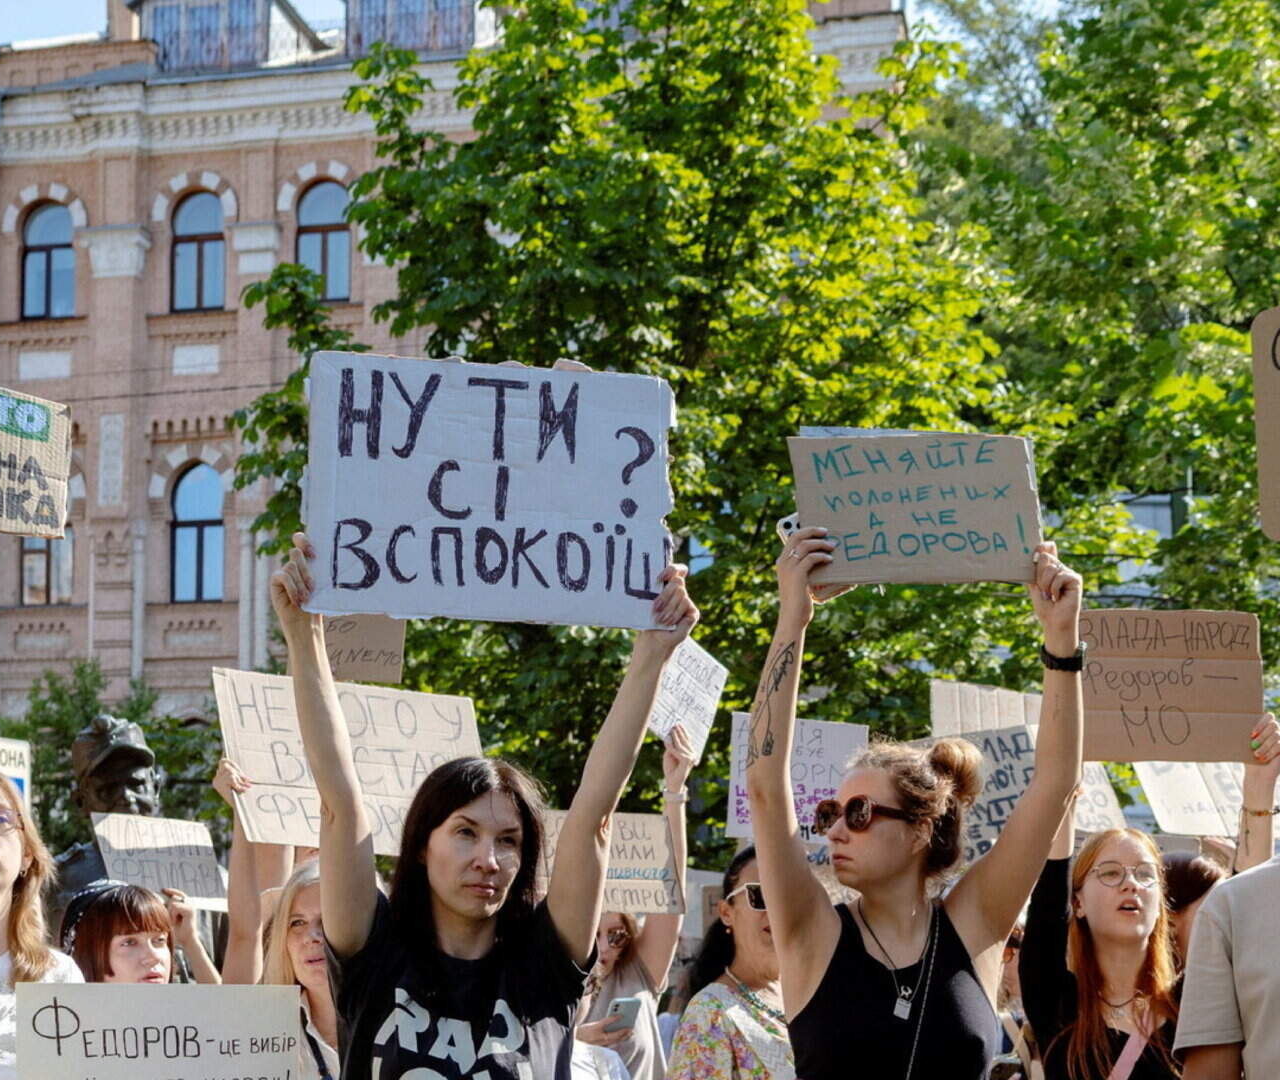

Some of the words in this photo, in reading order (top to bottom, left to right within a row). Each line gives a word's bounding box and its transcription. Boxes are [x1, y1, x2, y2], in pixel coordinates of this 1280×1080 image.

[338, 367, 442, 460] НУ
[468, 377, 579, 464] ТИ
[912, 509, 958, 527] НЕ
[1120, 703, 1192, 748] МО
